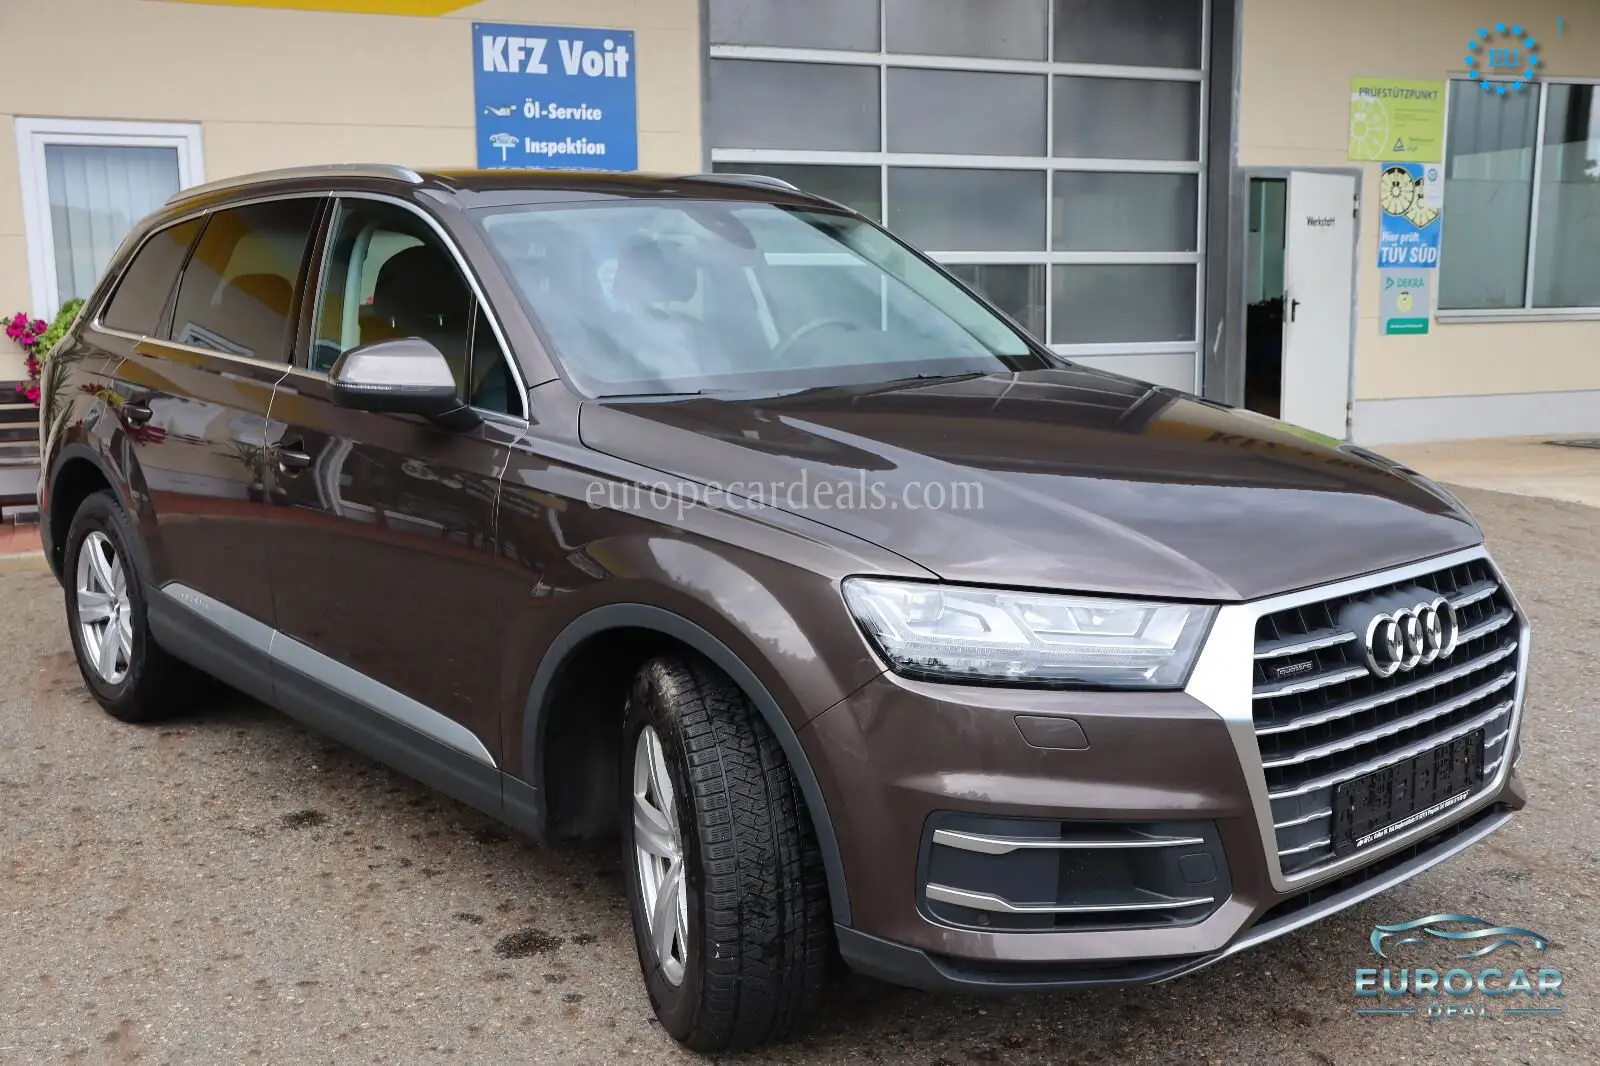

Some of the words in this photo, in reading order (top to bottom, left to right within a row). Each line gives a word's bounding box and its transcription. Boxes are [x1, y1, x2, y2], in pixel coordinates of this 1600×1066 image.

[482, 35, 548, 74] KFZ
[558, 39, 629, 77] Voit
[1358, 86, 1438, 99] PRÜFSTÜTZPUNKT
[523, 97, 602, 120] Öl-Service
[525, 137, 606, 157] Inspektion
[1381, 243, 1408, 263] TÜV
[1409, 243, 1437, 263] SÜD
[1396, 277, 1424, 288] DEKRA
